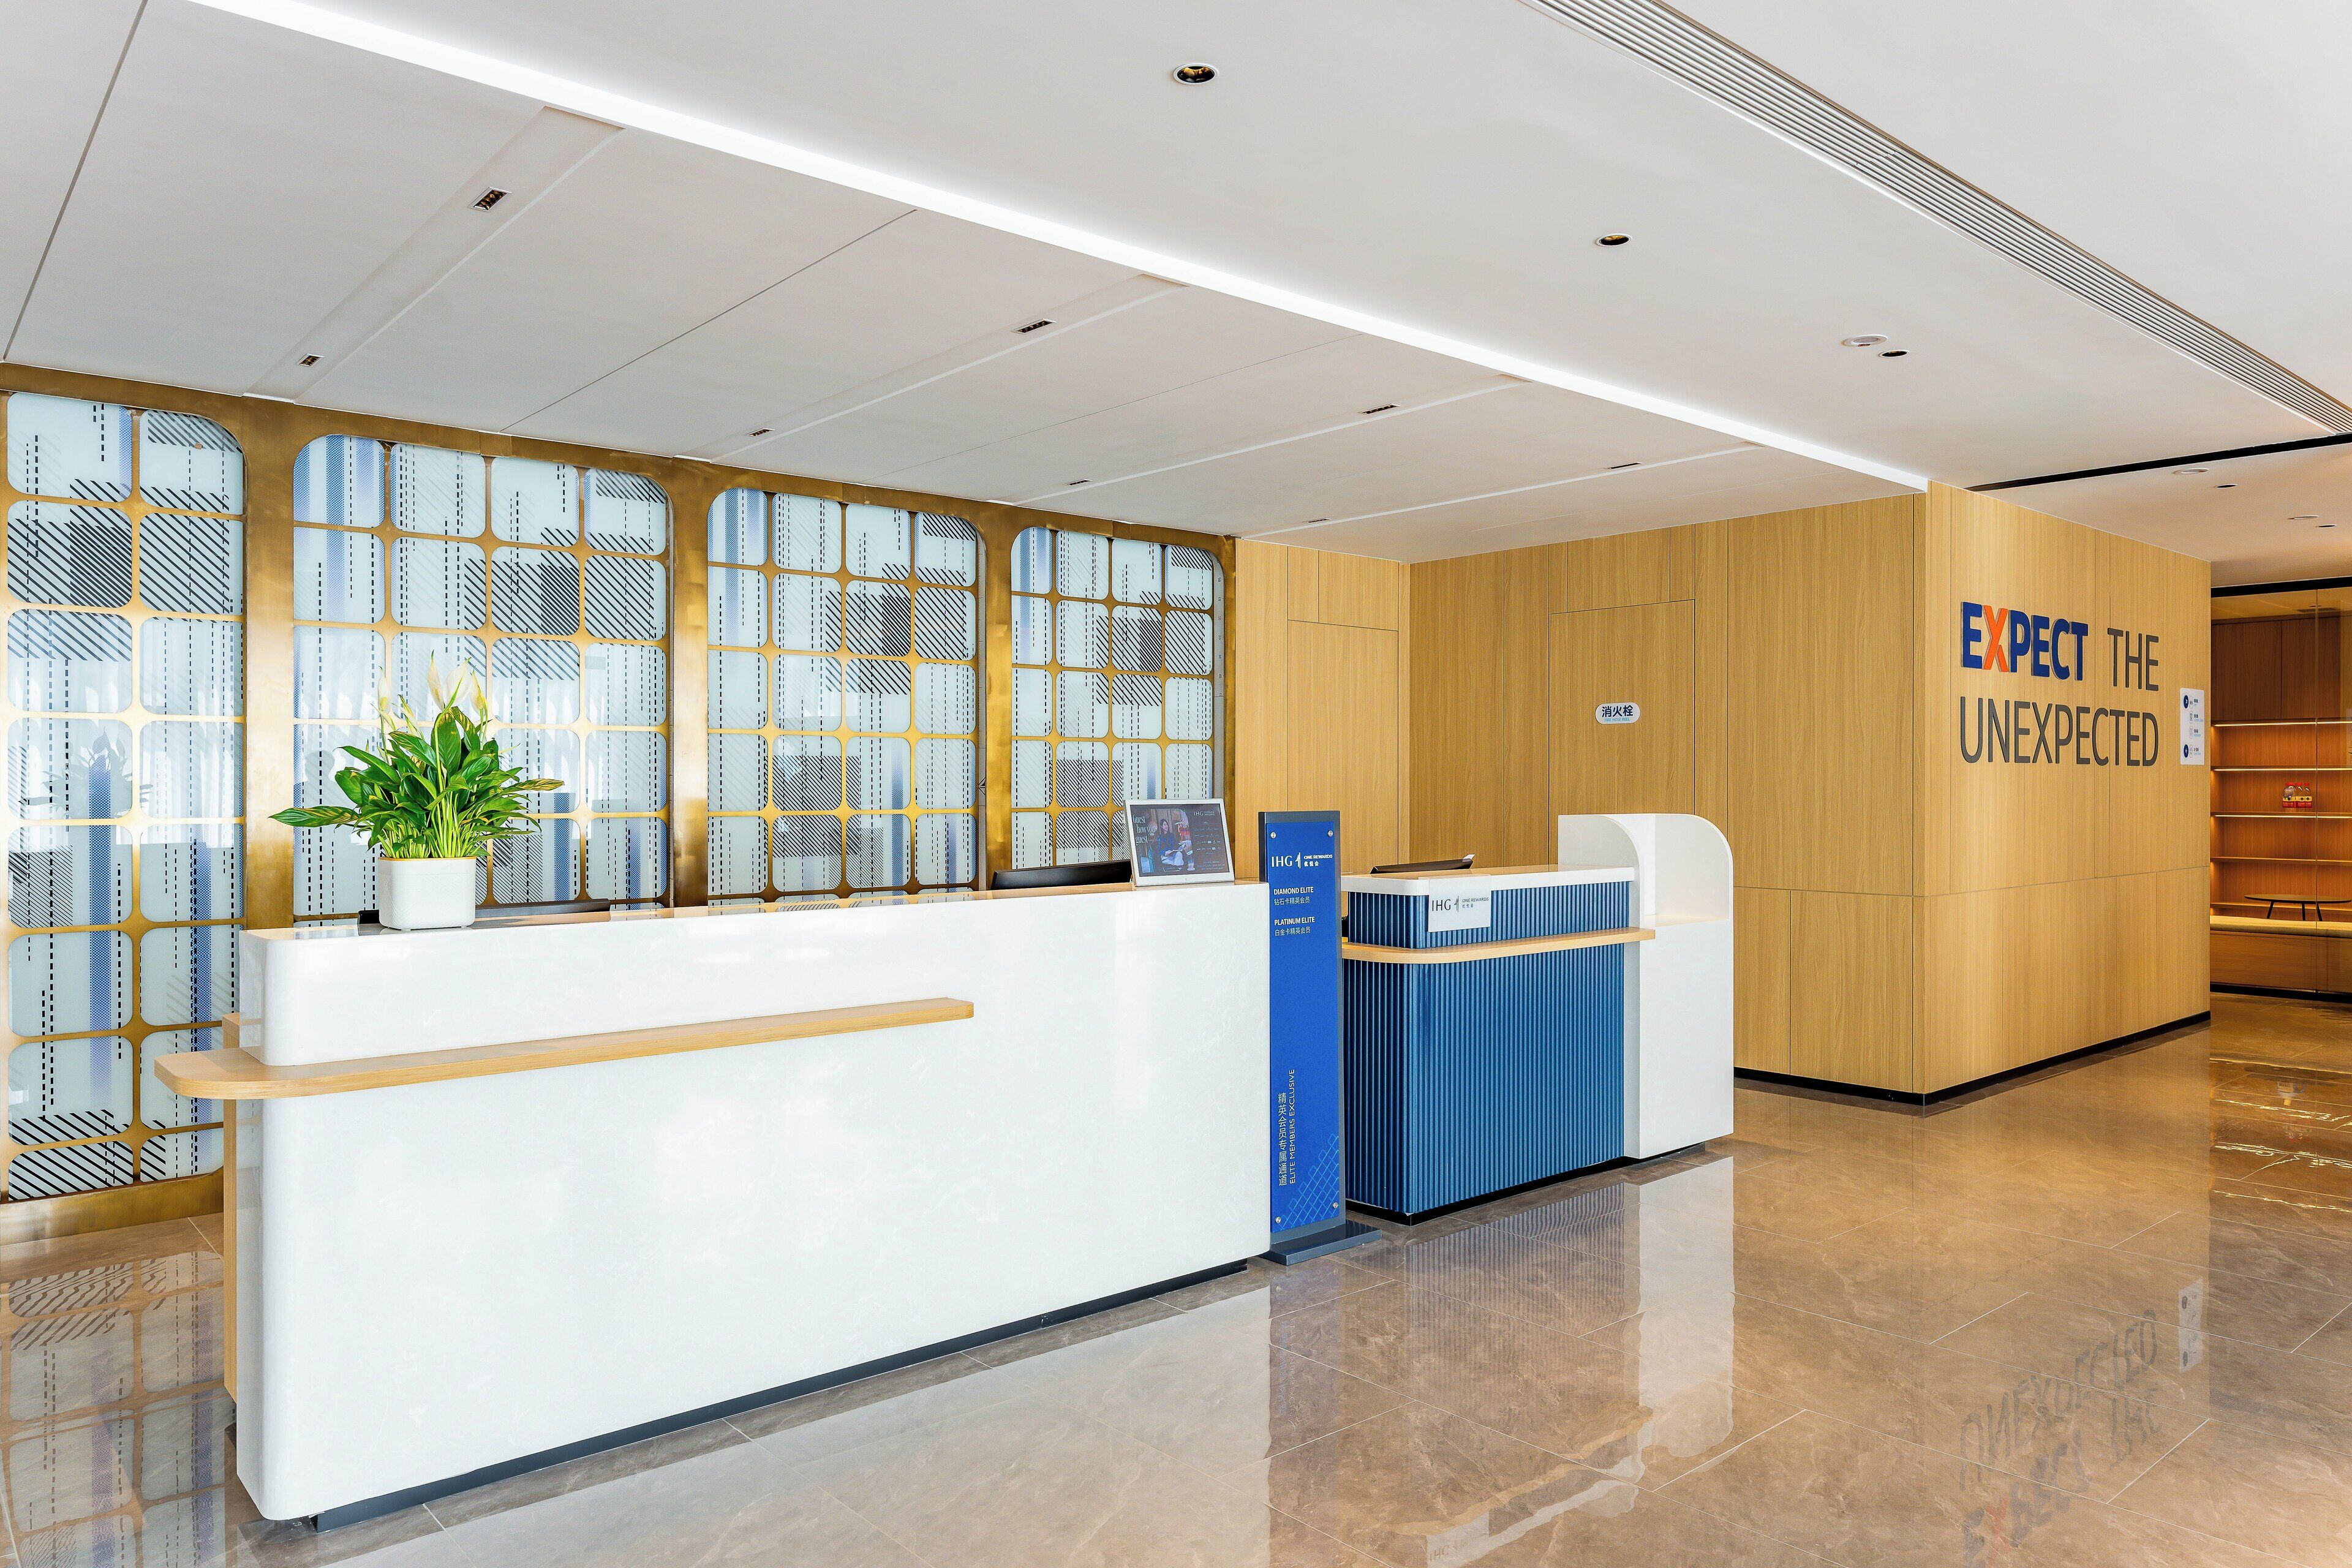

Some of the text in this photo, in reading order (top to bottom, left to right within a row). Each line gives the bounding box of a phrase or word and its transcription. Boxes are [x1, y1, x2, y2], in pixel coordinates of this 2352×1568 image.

[1960, 601, 2159, 692] EXPECT THE
[1602, 704, 1634, 718] 消火栓
[1960, 696, 2159, 767] UNEXPECTED
[1133, 815, 1145, 824] Guest
[1136, 824, 1146, 834] how
[1135, 835, 1148, 846] guest
[1271, 855, 1292, 868] IHG
[1274, 896, 1310, 906] 钻石卡精英会员
[1431, 899, 1451, 911] IHG
[1274, 918, 1301, 926] PLATINUM
[1275, 926, 1311, 937] 白金卡精英会员
[1278, 1092, 1287, 1186] 精英会员专属通道
